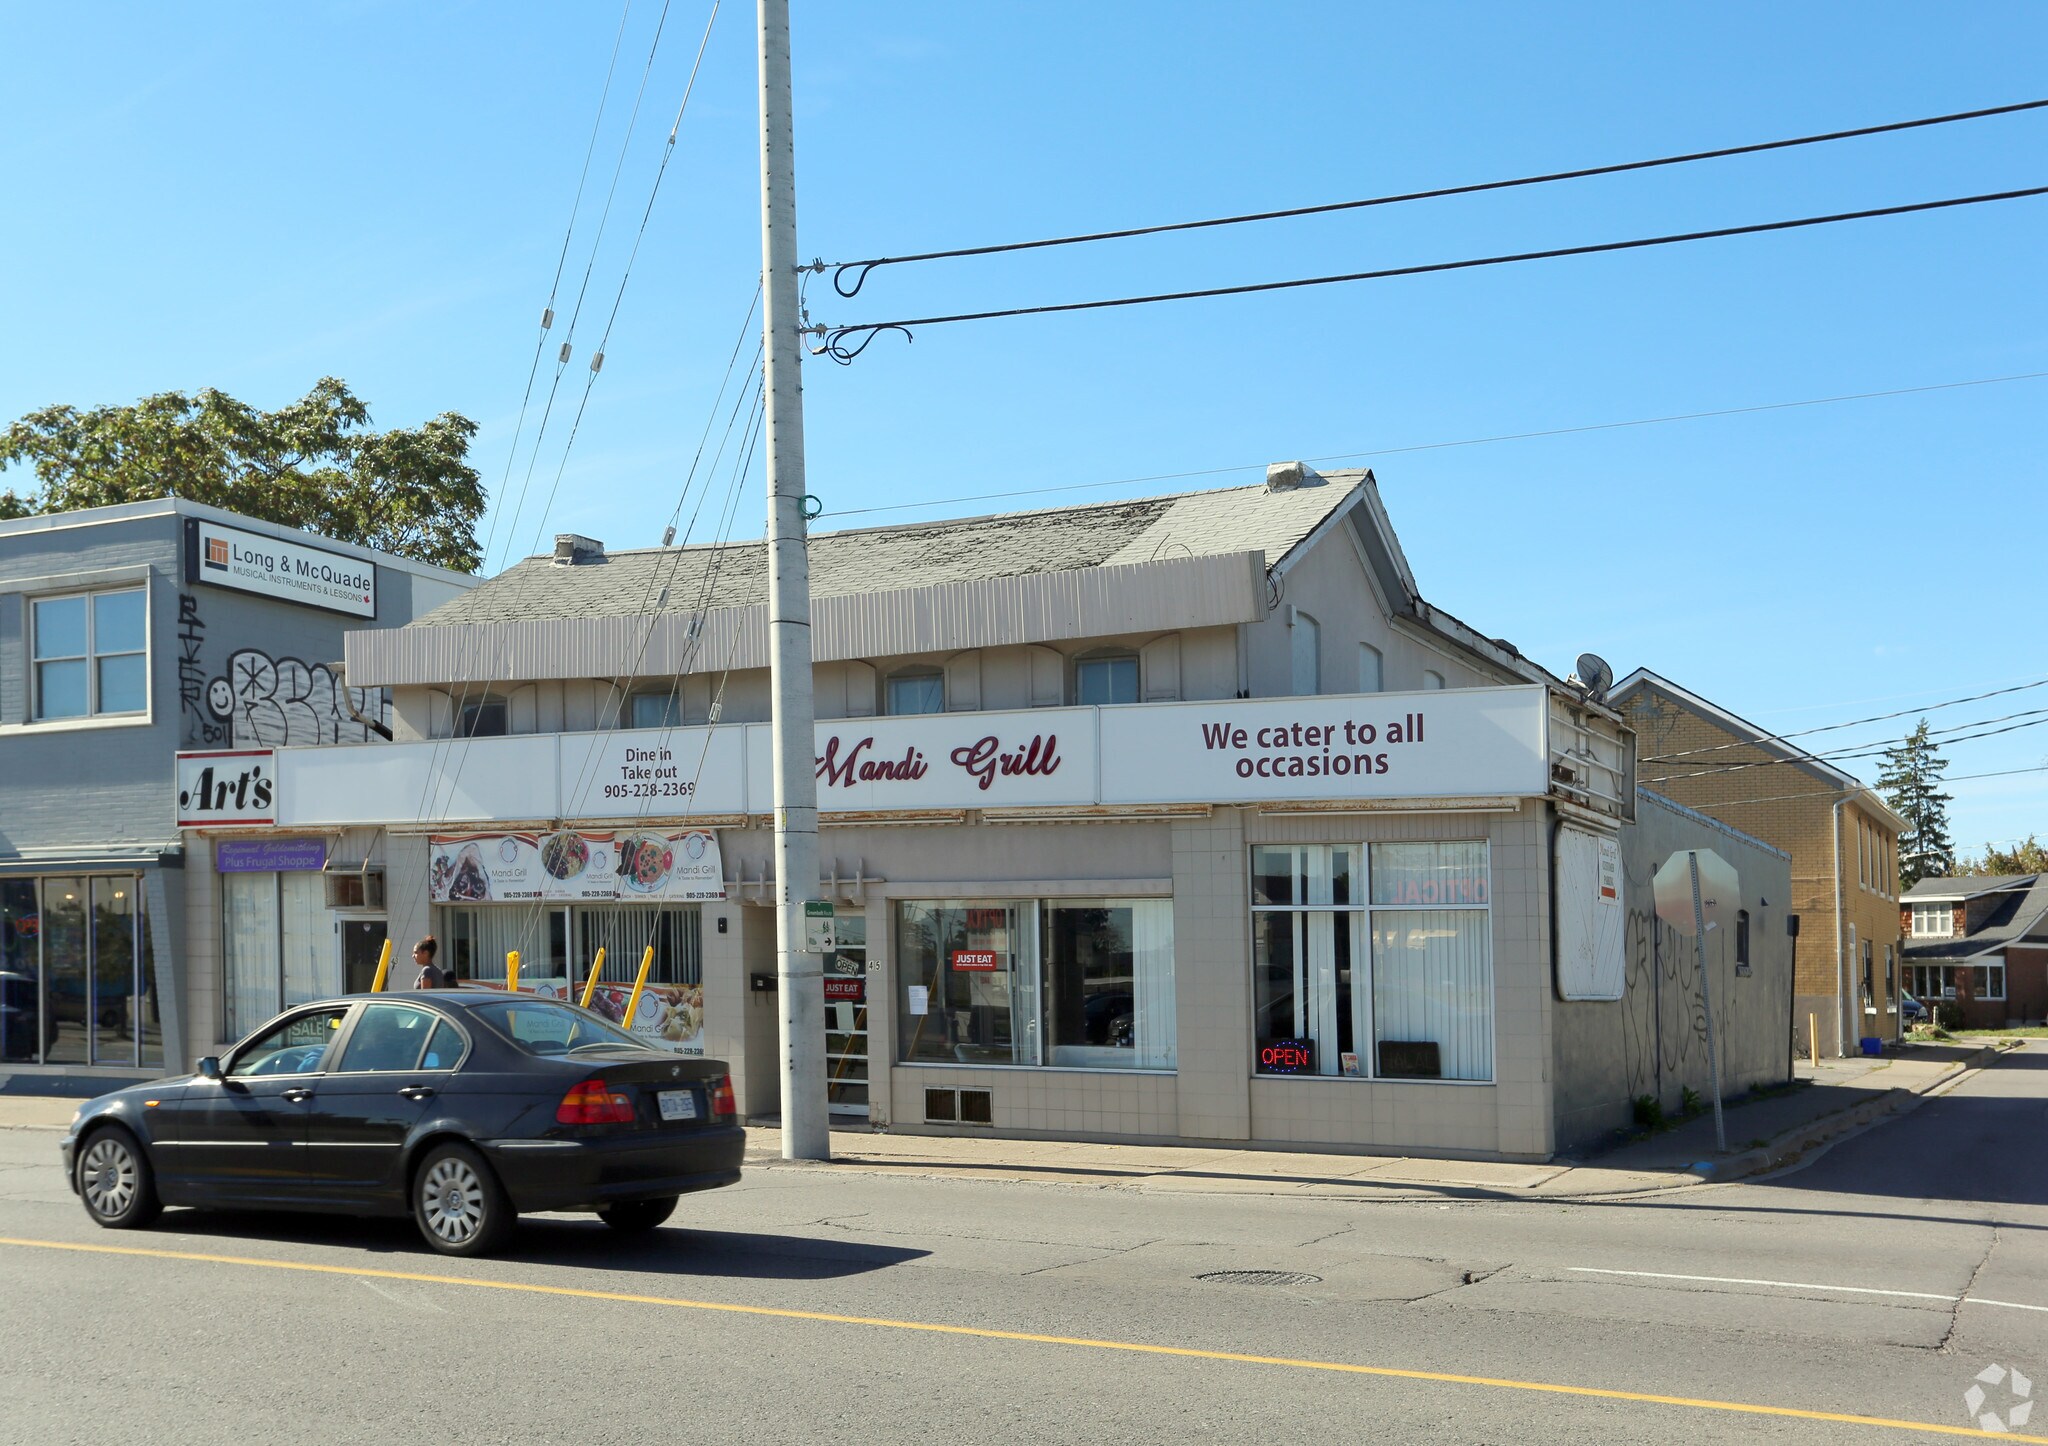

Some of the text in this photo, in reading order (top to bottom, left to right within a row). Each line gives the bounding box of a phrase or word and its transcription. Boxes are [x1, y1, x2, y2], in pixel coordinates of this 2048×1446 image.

[233, 544, 370, 591] Long & McQuade
[234, 566, 362, 602] MUSICAL INSTRUMENTS & LESSONS
[1201, 713, 1424, 750] We cater to all
[626, 746, 672, 762] Dine in
[815, 734, 1061, 790] Mandi Grill
[1236, 748, 1389, 778] occasions
[621, 766, 678, 780] Take out
[180, 765, 272, 810] Art's
[604, 782, 695, 798] 905-228-2369
[225, 855, 315, 869] Plus Frugal Shoppe
[676, 866, 716, 874] Mandi Grill
[492, 868, 528, 877] Mandi Grill
[868, 961, 880, 971] 45
[956, 954, 992, 963] JUST EAT
[836, 960, 859, 976] OPEN
[826, 984, 858, 992] JUST EAT
[292, 1022, 322, 1036] SALE
[1262, 1048, 1307, 1066] OPEN
